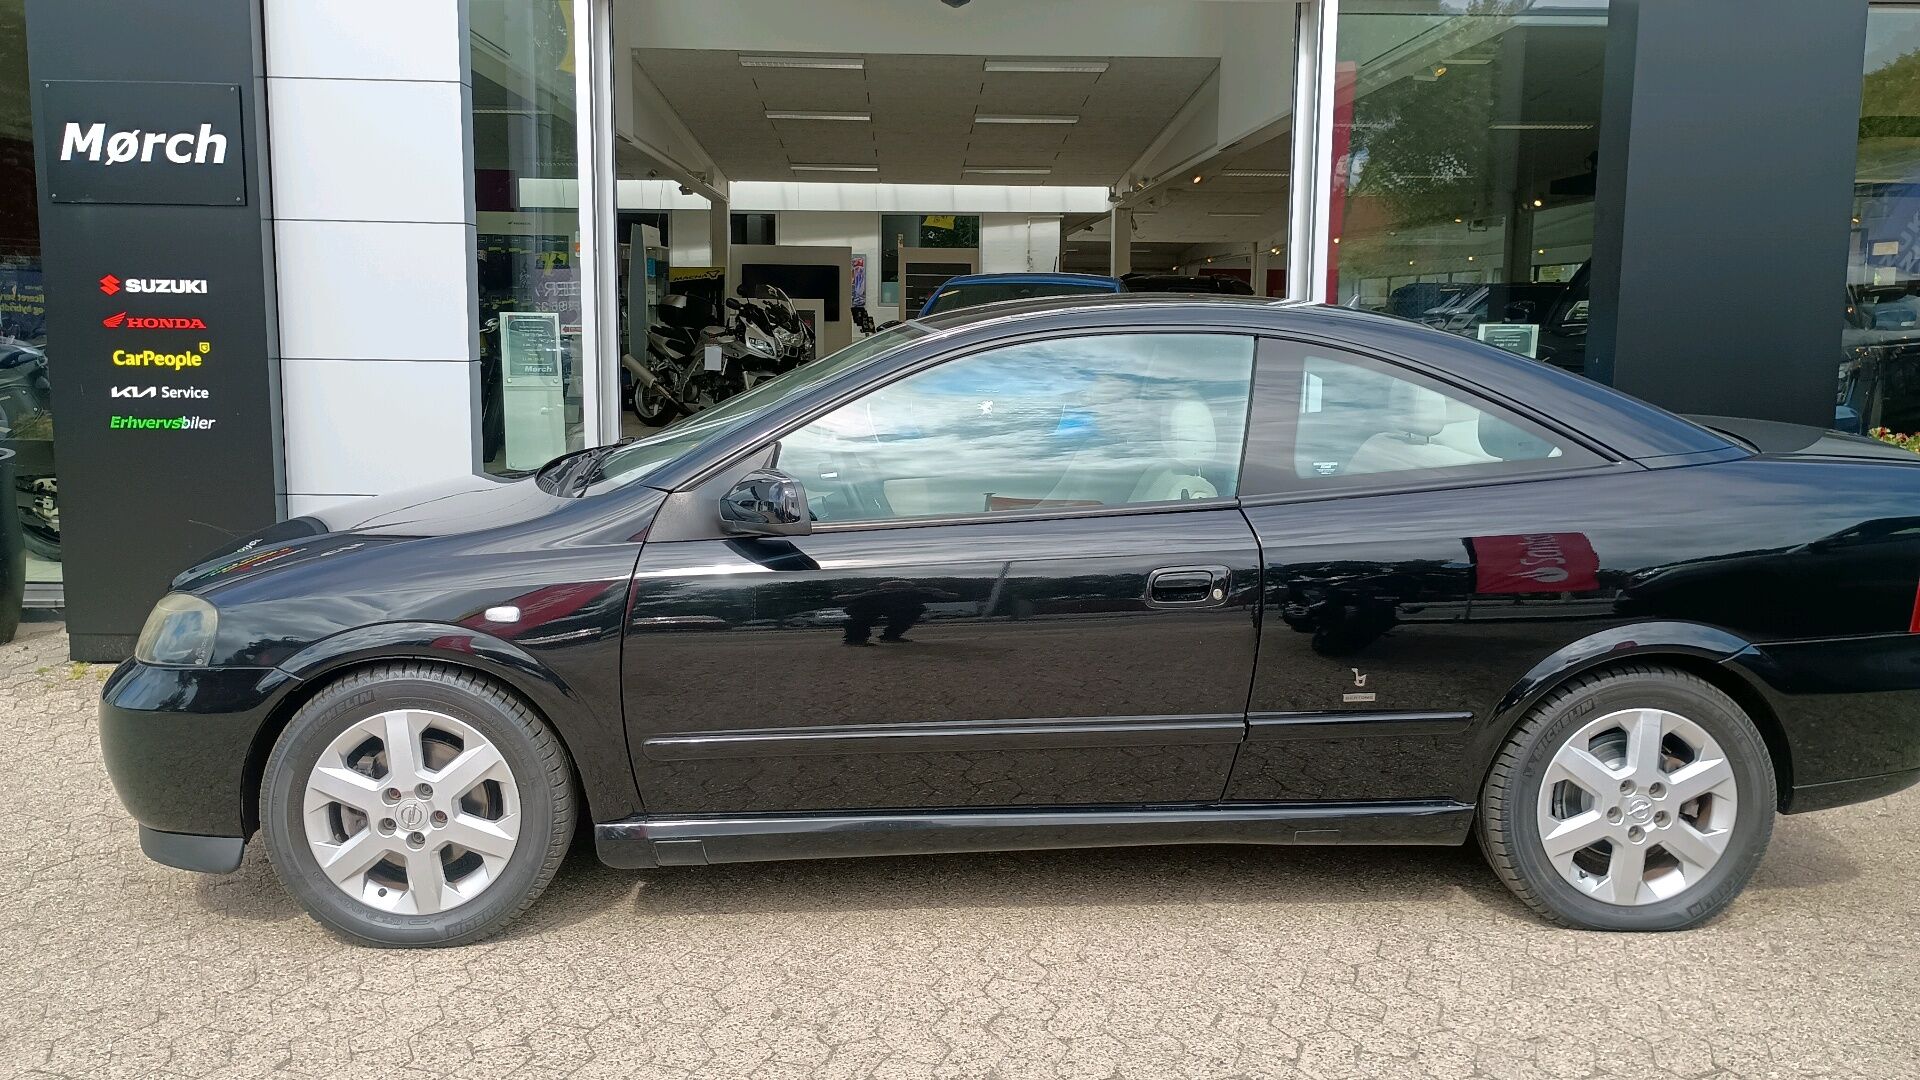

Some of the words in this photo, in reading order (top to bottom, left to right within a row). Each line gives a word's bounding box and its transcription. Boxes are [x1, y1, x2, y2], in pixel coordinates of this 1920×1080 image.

[60, 122, 227, 166] Mørch
[125, 278, 208, 294] SUZUKI
[126, 317, 207, 329] HONDA
[112, 349, 203, 371] CarPeople
[161, 386, 210, 399] Service
[110, 415, 216, 430] Erhvervsbiler
